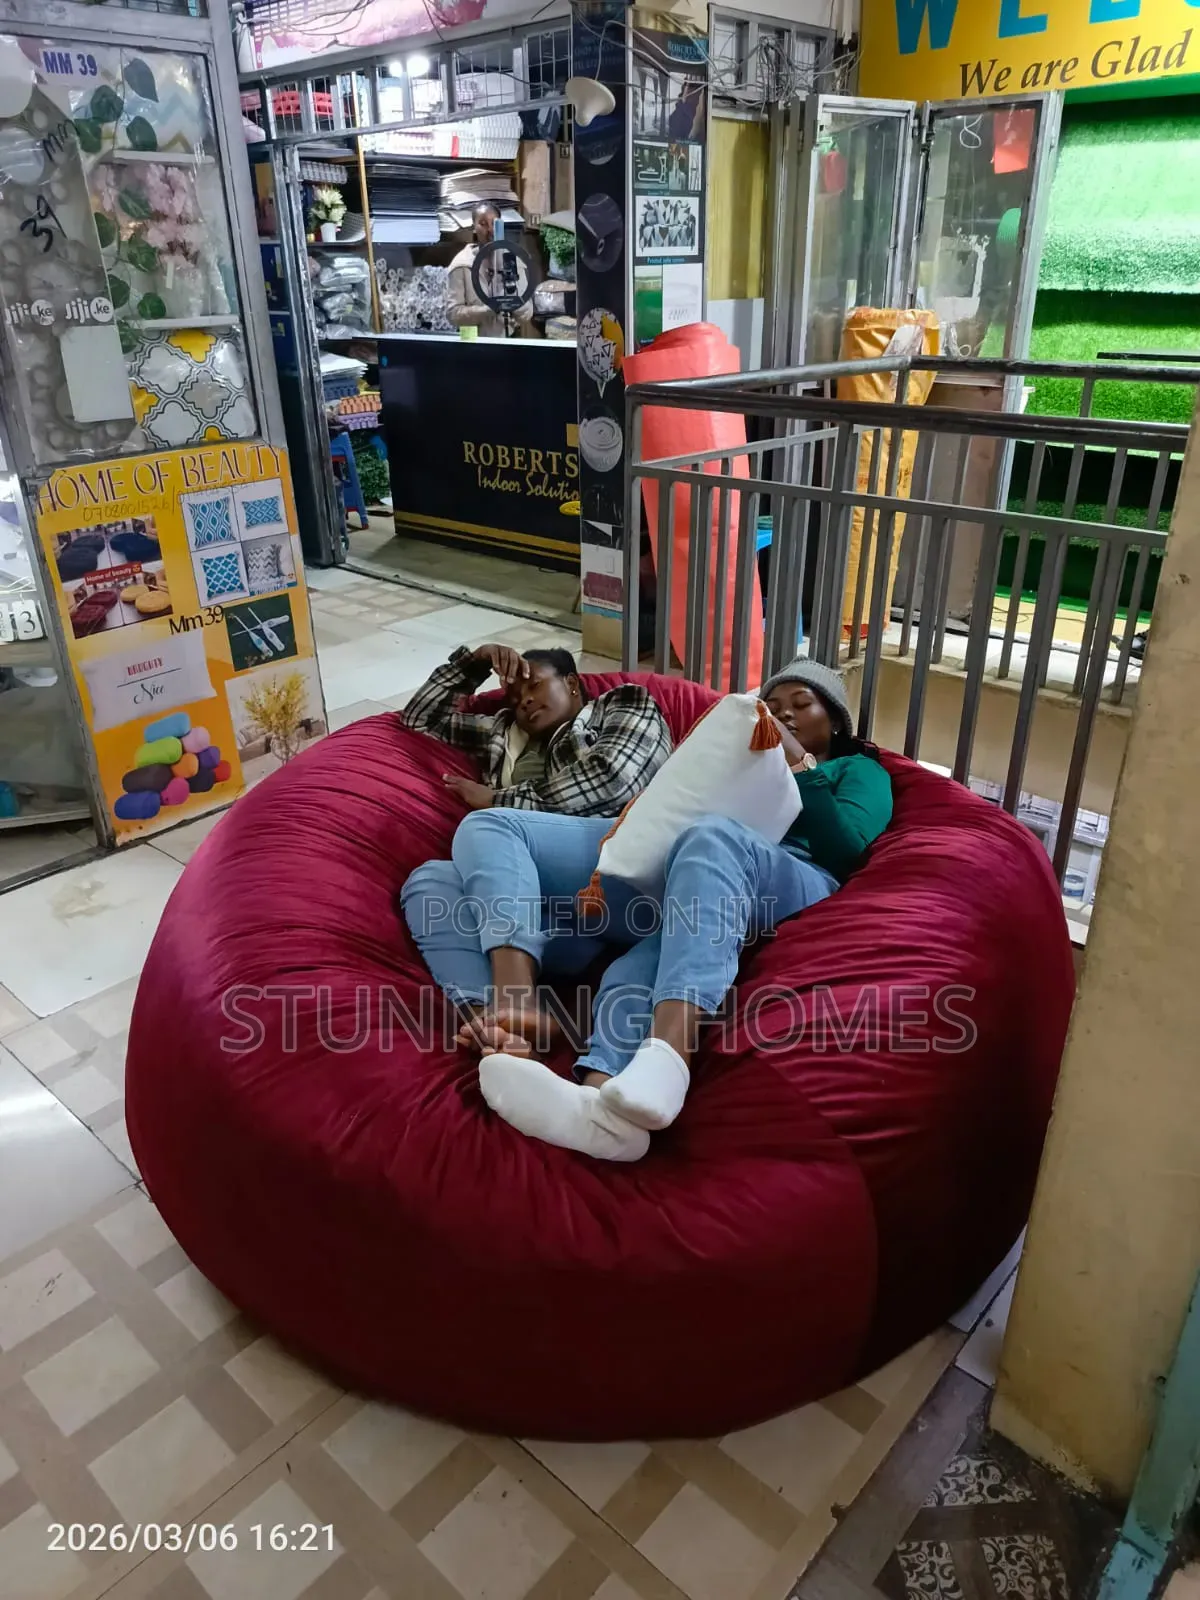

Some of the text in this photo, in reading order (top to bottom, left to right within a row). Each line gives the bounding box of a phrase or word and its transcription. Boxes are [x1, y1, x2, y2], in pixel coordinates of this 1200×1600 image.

[43, 51, 98, 77] MM 39
[959, 58, 1012, 97] We
[1020, 56, 1079, 89] are
[1090, 28, 1194, 79] Glad
[462, 440, 579, 478] ROBERTS
[36, 466, 129, 516] HOME
[133, 459, 172, 496] OF
[179, 444, 284, 488] BEAUTY
[477, 465, 522, 493] Indoor
[86, 573, 105, 583] Home
[105, 570, 112, 578] of
[20, 610, 36, 634] 3
